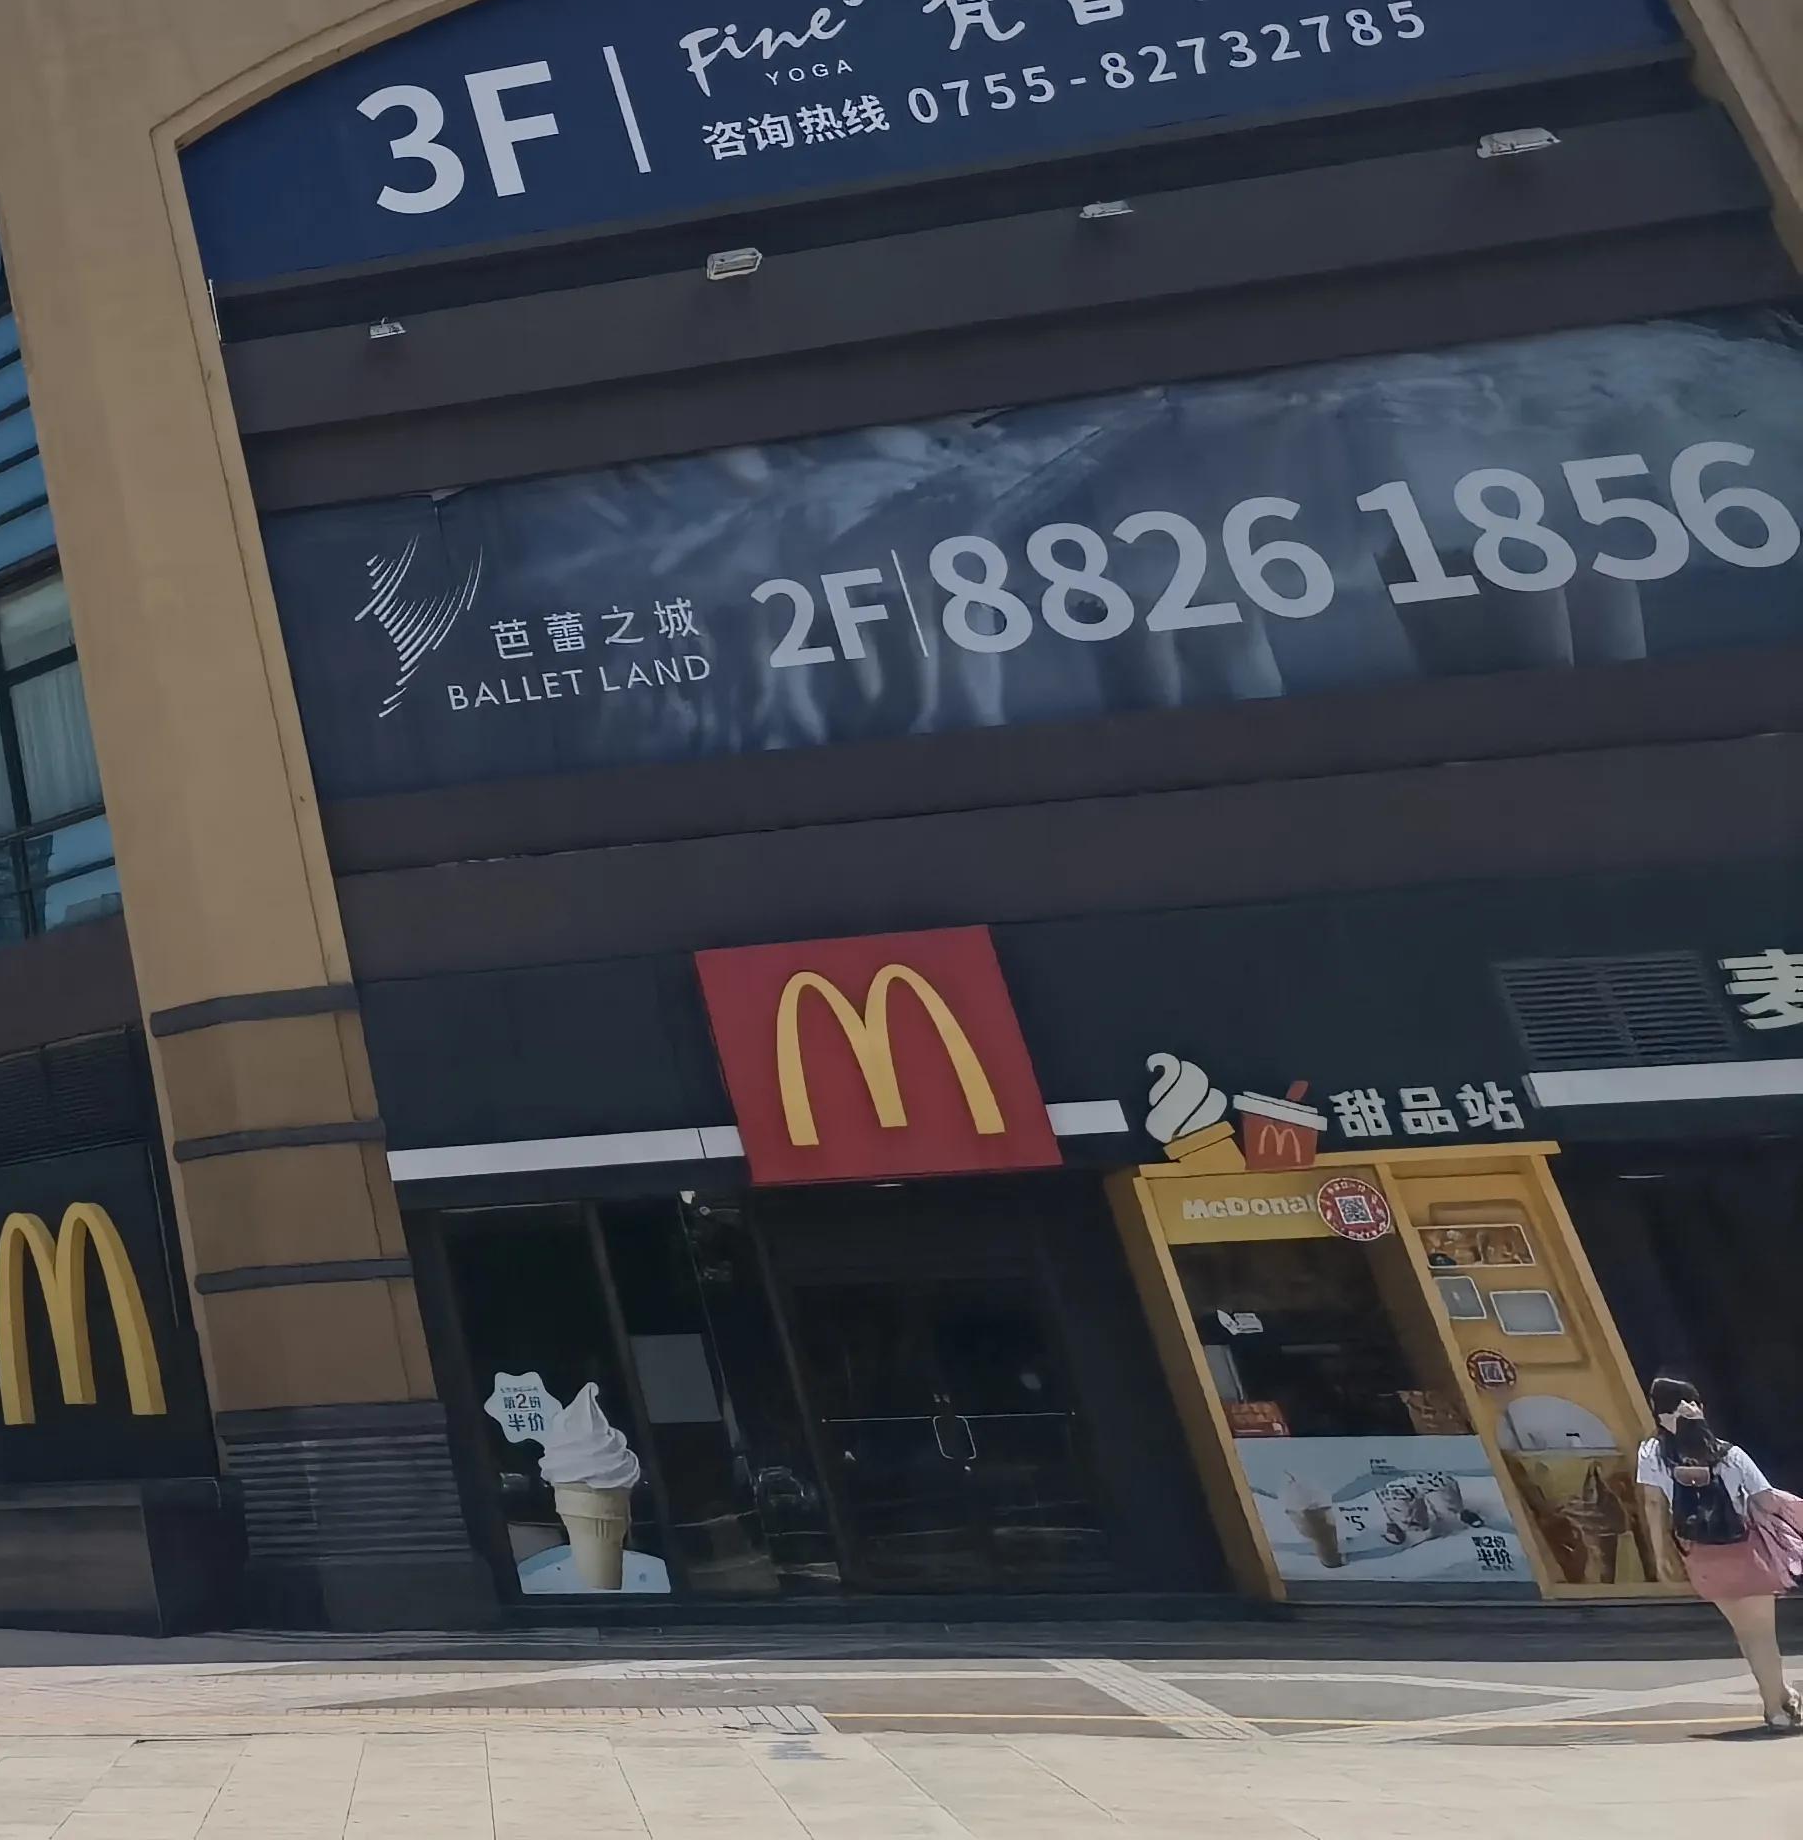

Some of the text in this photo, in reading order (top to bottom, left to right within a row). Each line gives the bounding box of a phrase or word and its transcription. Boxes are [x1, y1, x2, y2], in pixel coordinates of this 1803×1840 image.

[679, 7, 846, 97] Fine
[702, 0, 1426, 161] 咨询热线 0755-82732785
[765, 59, 854, 87] YOGA
[356, 60, 560, 214] 3F
[750, 441, 1801, 669] 2F 8826 1856
[490, 596, 703, 659] 芭蕾之城
[447, 654, 711, 712] BALLET LAND
[1328, 1080, 1525, 1138] 甜品站
[1182, 1193, 1318, 1221] McDonal
[508, 1413, 545, 1432] 半价
